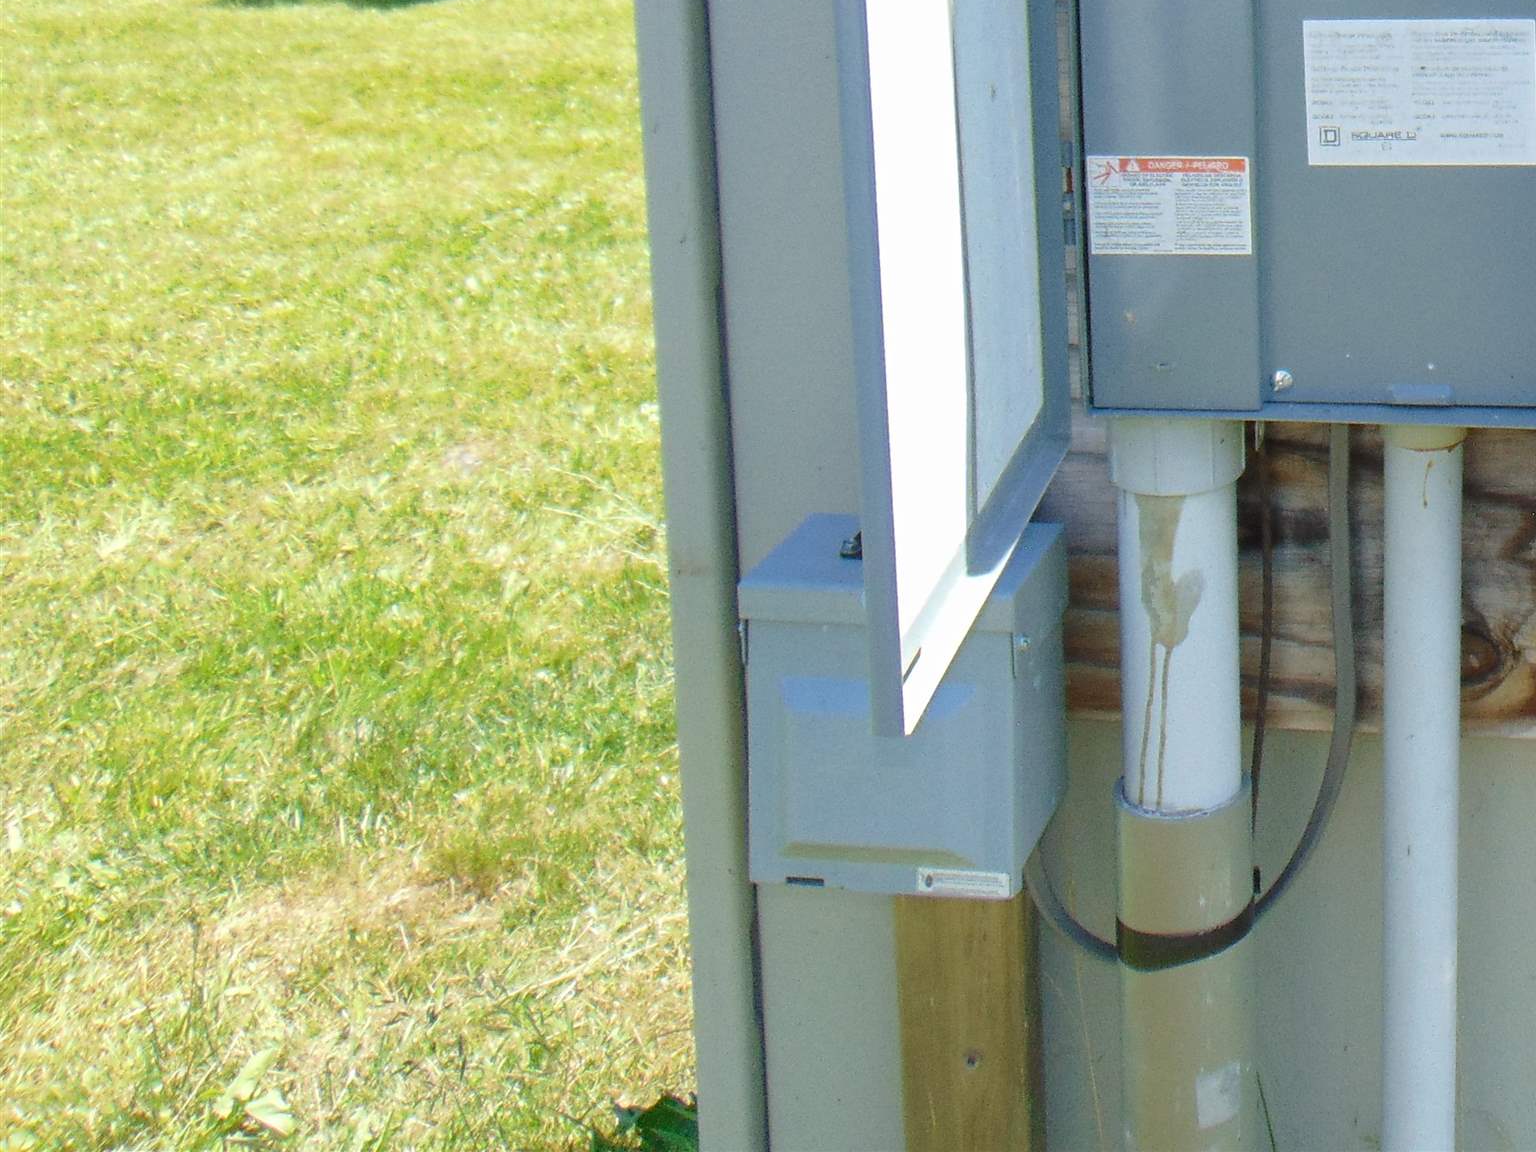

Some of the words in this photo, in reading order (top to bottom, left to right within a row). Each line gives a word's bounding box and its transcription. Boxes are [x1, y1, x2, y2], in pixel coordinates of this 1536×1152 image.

[1323, 129, 1337, 144] D
[1351, 131, 1401, 139] SQUARE
[1147, 161, 1183, 169] DANGER
